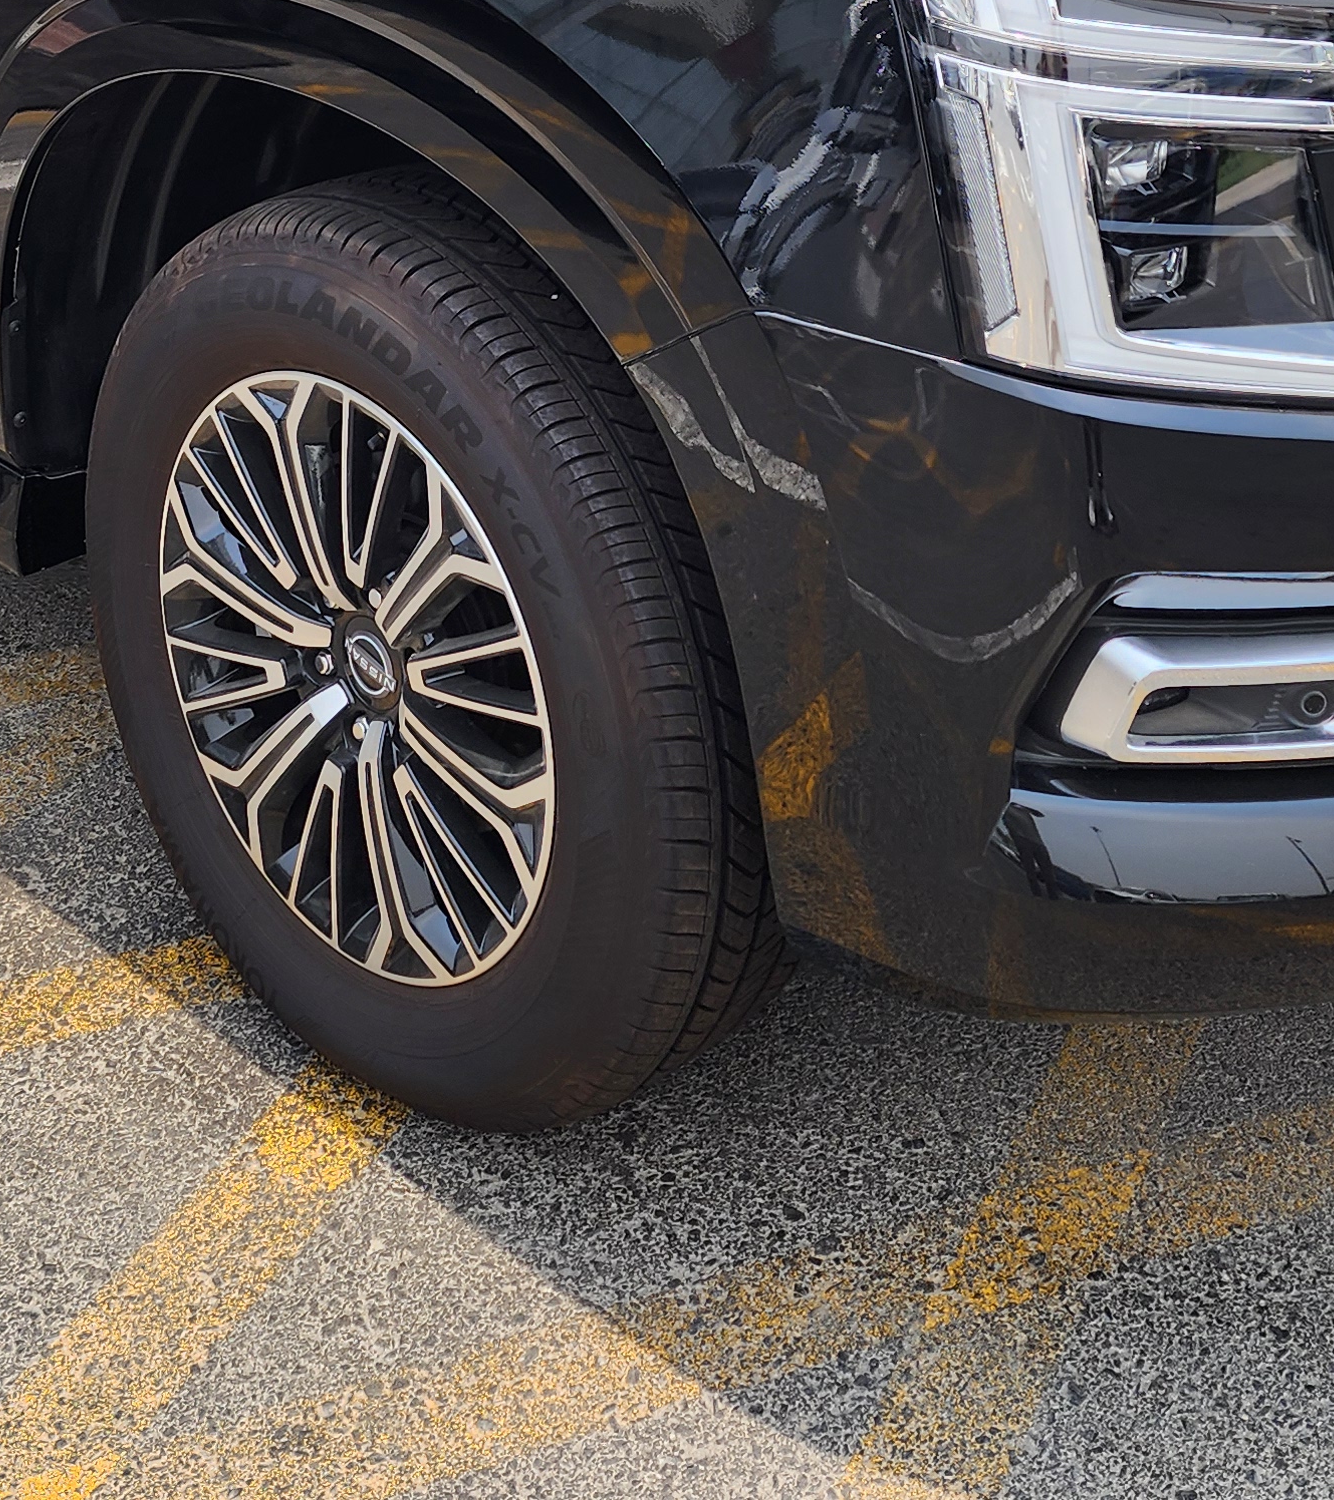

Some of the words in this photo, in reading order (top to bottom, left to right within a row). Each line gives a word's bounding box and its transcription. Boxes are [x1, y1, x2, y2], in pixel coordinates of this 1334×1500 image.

[195, 276, 483, 455] GEOLANDAR
[479, 466, 563, 599] X-CV
[344, 637, 396, 693] NISSAN
